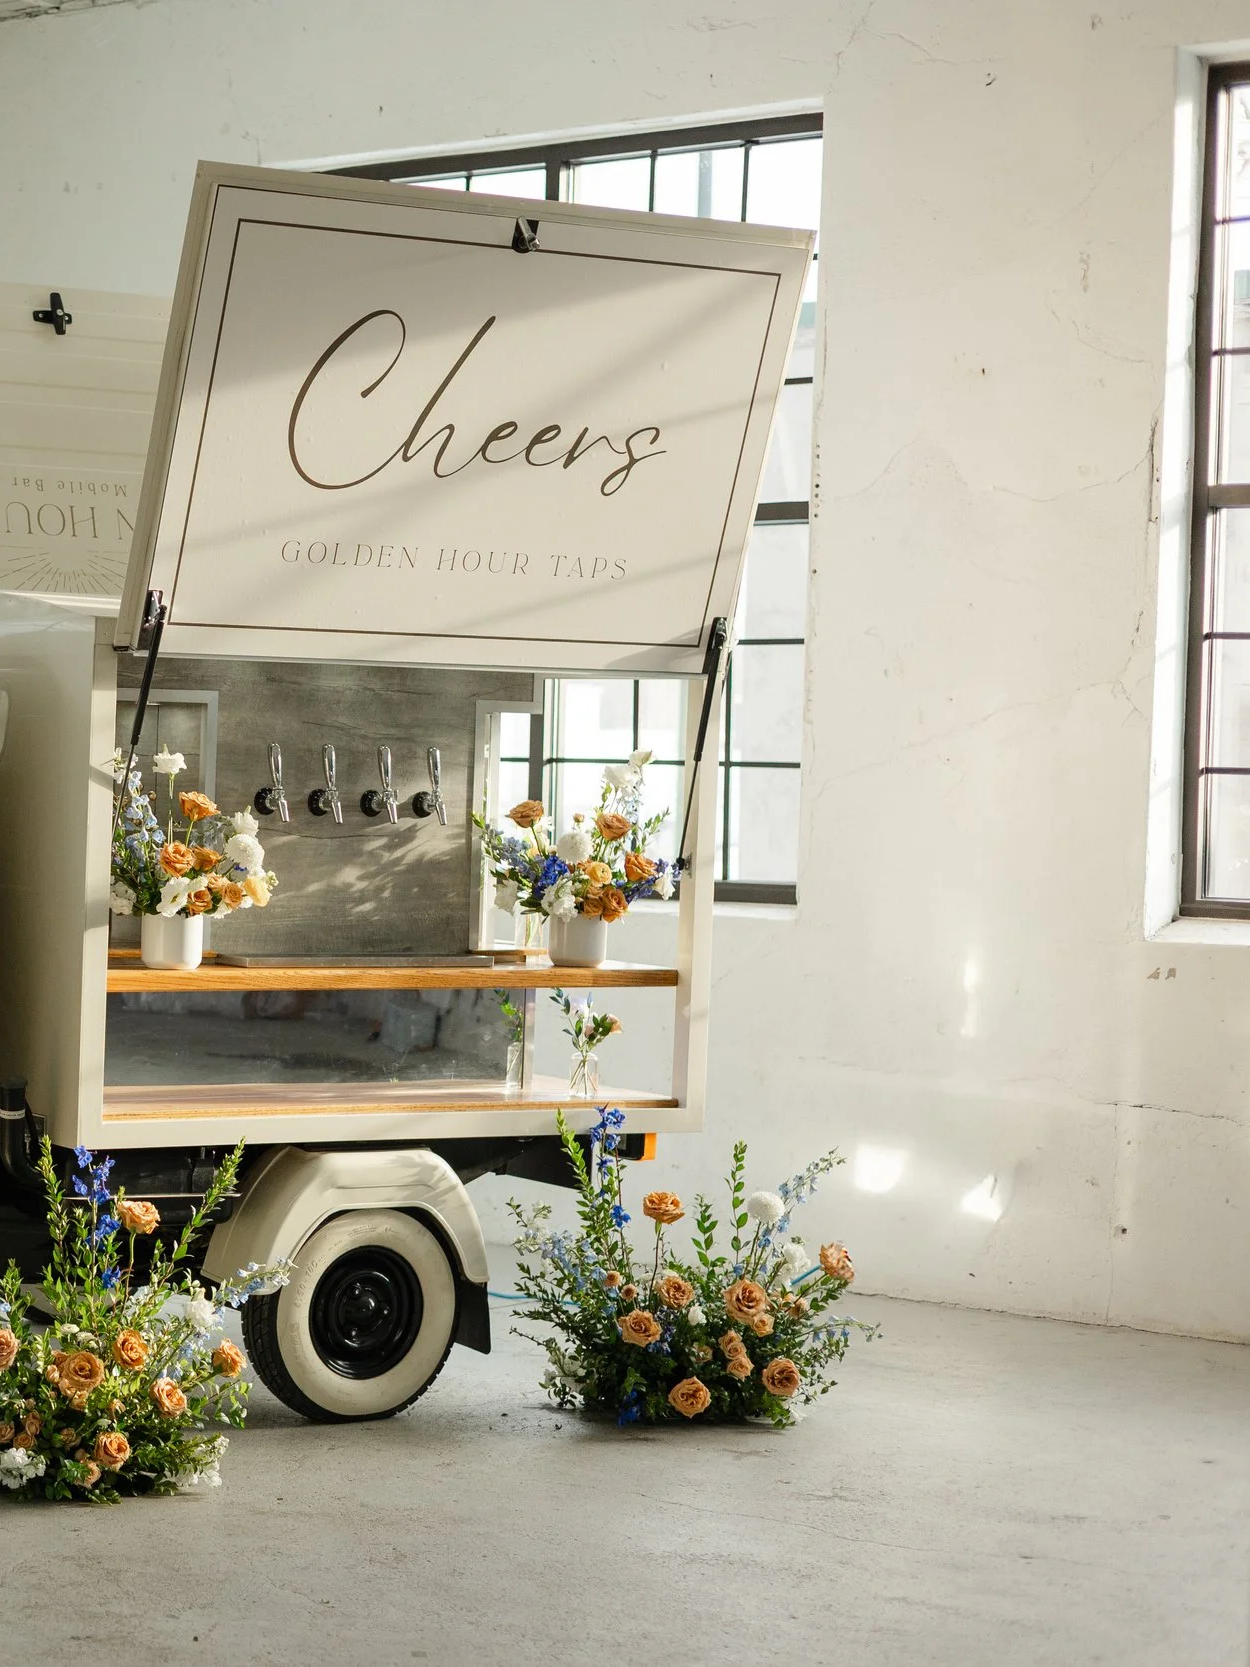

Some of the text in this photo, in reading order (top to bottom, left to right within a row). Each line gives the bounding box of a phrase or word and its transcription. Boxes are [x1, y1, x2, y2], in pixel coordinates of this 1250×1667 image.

[288, 309, 668, 497] Cheers
[12, 476, 45, 492] Bar
[57, 480, 128, 498] Mobile
[281, 539, 627, 580] GOLDEN HOUR TAPS
